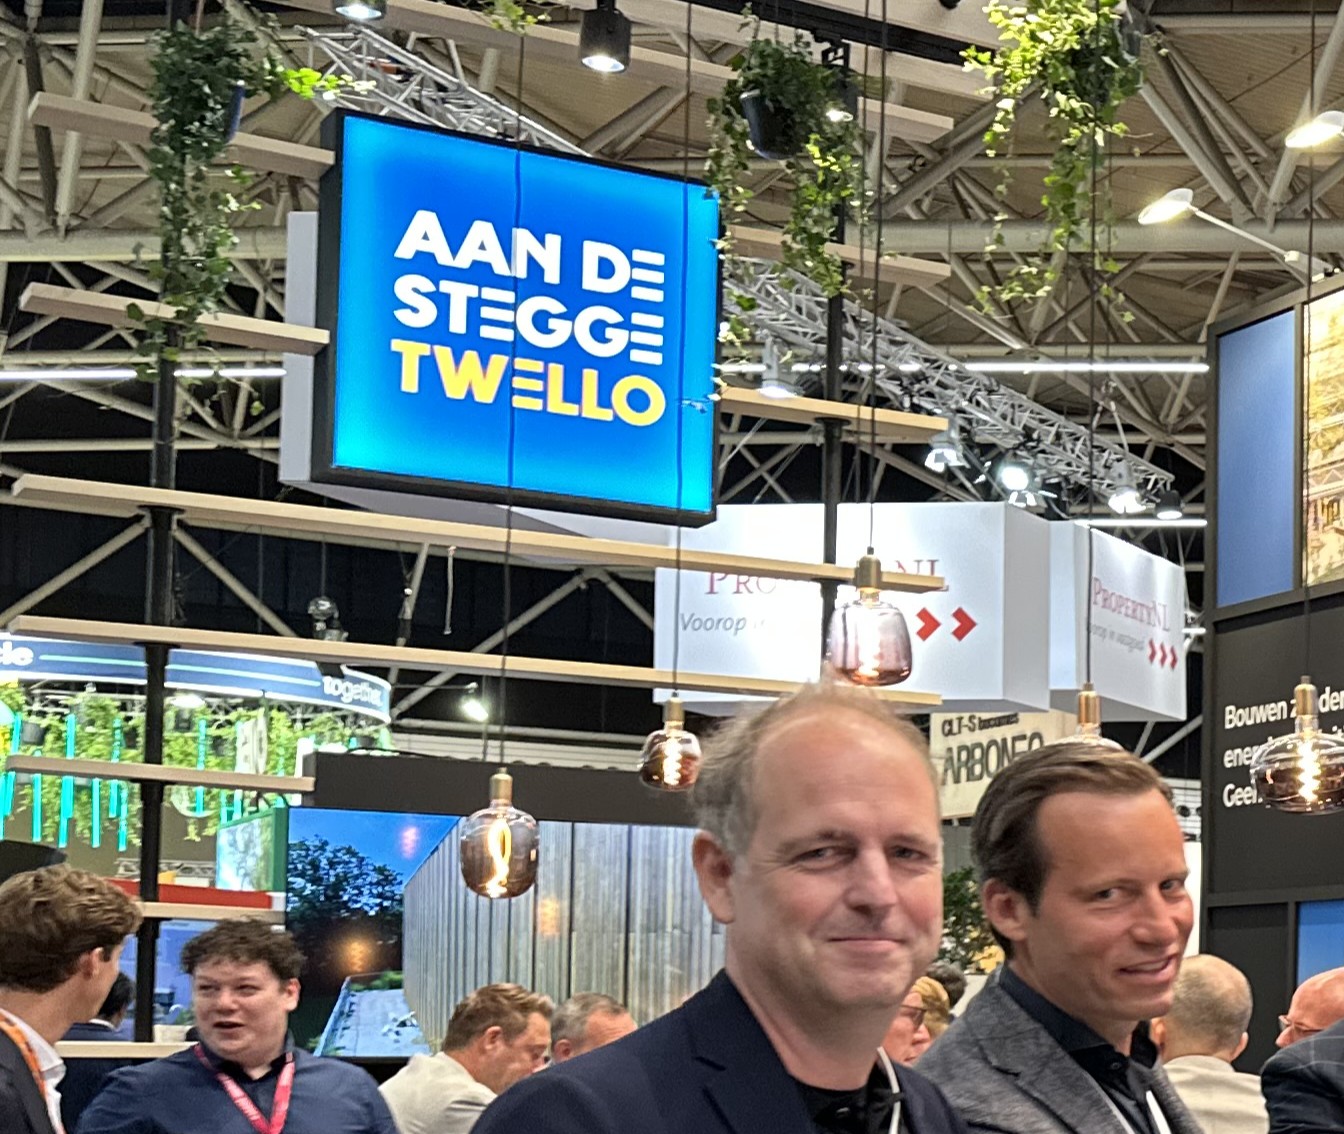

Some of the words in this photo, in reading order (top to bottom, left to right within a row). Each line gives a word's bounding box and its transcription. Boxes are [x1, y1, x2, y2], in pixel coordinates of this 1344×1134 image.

[394, 209, 562, 284] AAN
[581, 240, 665, 302] DE
[393, 273, 664, 365] STEGGE
[390, 338, 666, 426] TWELLO
[680, 612, 746, 636] Voorop
[1224, 701, 1288, 729] Bouwen
